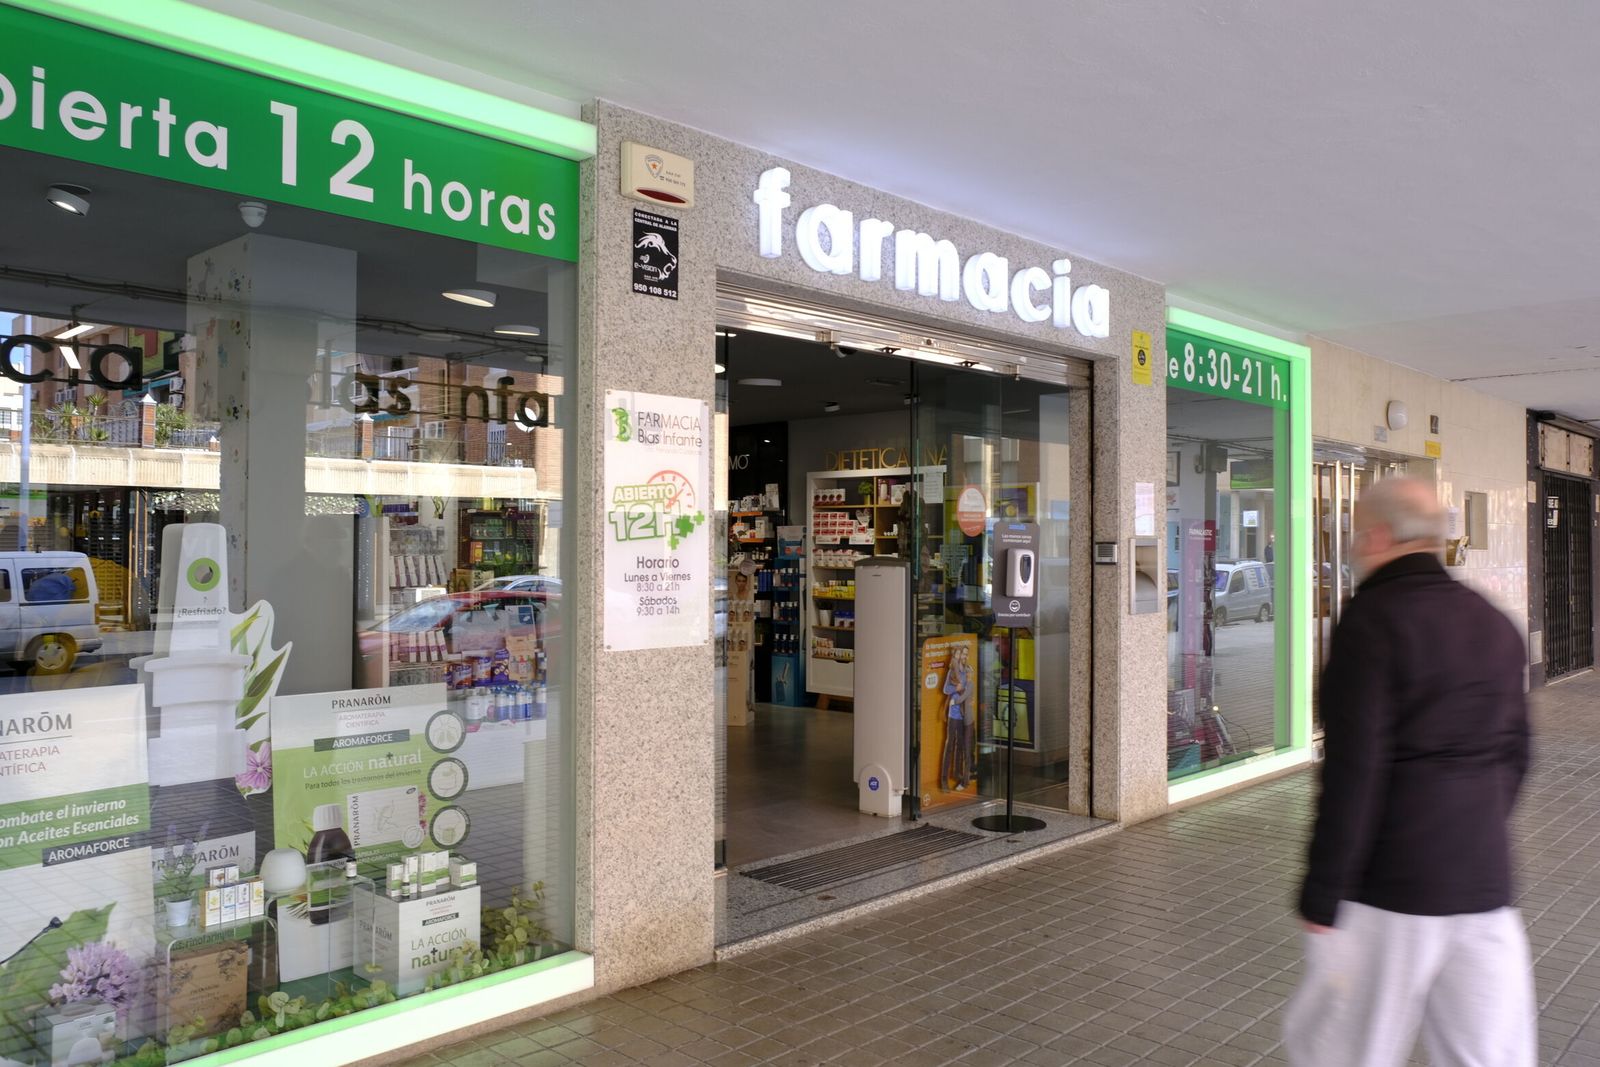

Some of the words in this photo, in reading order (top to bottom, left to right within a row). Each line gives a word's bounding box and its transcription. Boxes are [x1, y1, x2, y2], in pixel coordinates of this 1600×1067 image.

[269, 100, 375, 204] 12
[403, 159, 557, 242] horas
[753, 167, 1110, 338] farmacia
[633, 282, 648, 292] 950
[649, 286, 662, 295] 108
[663, 289, 677, 298] 512
[1166, 349, 1179, 379] e
[1183, 342, 1263, 397] 8:30-21
[1271, 365, 1287, 402] h.
[637, 411, 702, 432] FARMACIA
[637, 428, 660, 445] Blas
[662, 430, 702, 448] Infante
[825, 447, 909, 471] DIETETICA
[612, 483, 677, 504] ABIERTO
[636, 556, 680, 569] Horario
[624, 572, 649, 582] Lunes
[659, 571, 692, 582] Viernes
[636, 582, 654, 592] 8:30
[656, 583, 662, 591] a
[664, 581, 680, 592] 21h
[636, 605, 654, 616] 9:30
[656, 607, 662, 615] a
[665, 604, 680, 615] 14h
[639, 595, 678, 606] Sábados
[177, 606, 227, 618] ¿Resfriado?
[332, 733, 393, 748] AROMAFORCE
[303, 767, 317, 778] LA
[368, 749, 422, 770] natural
[305, 782, 320, 790] Para
[321, 778, 340, 788] todos
[56, 805, 69, 819] el
[71, 800, 127, 818] invierno
[17, 827, 70, 845] Aceites
[72, 814, 140, 835] Esenciales
[48, 837, 130, 863] AROMAFORCE
[411, 940, 425, 951] LA
[427, 927, 467, 947] ACCIÓN
